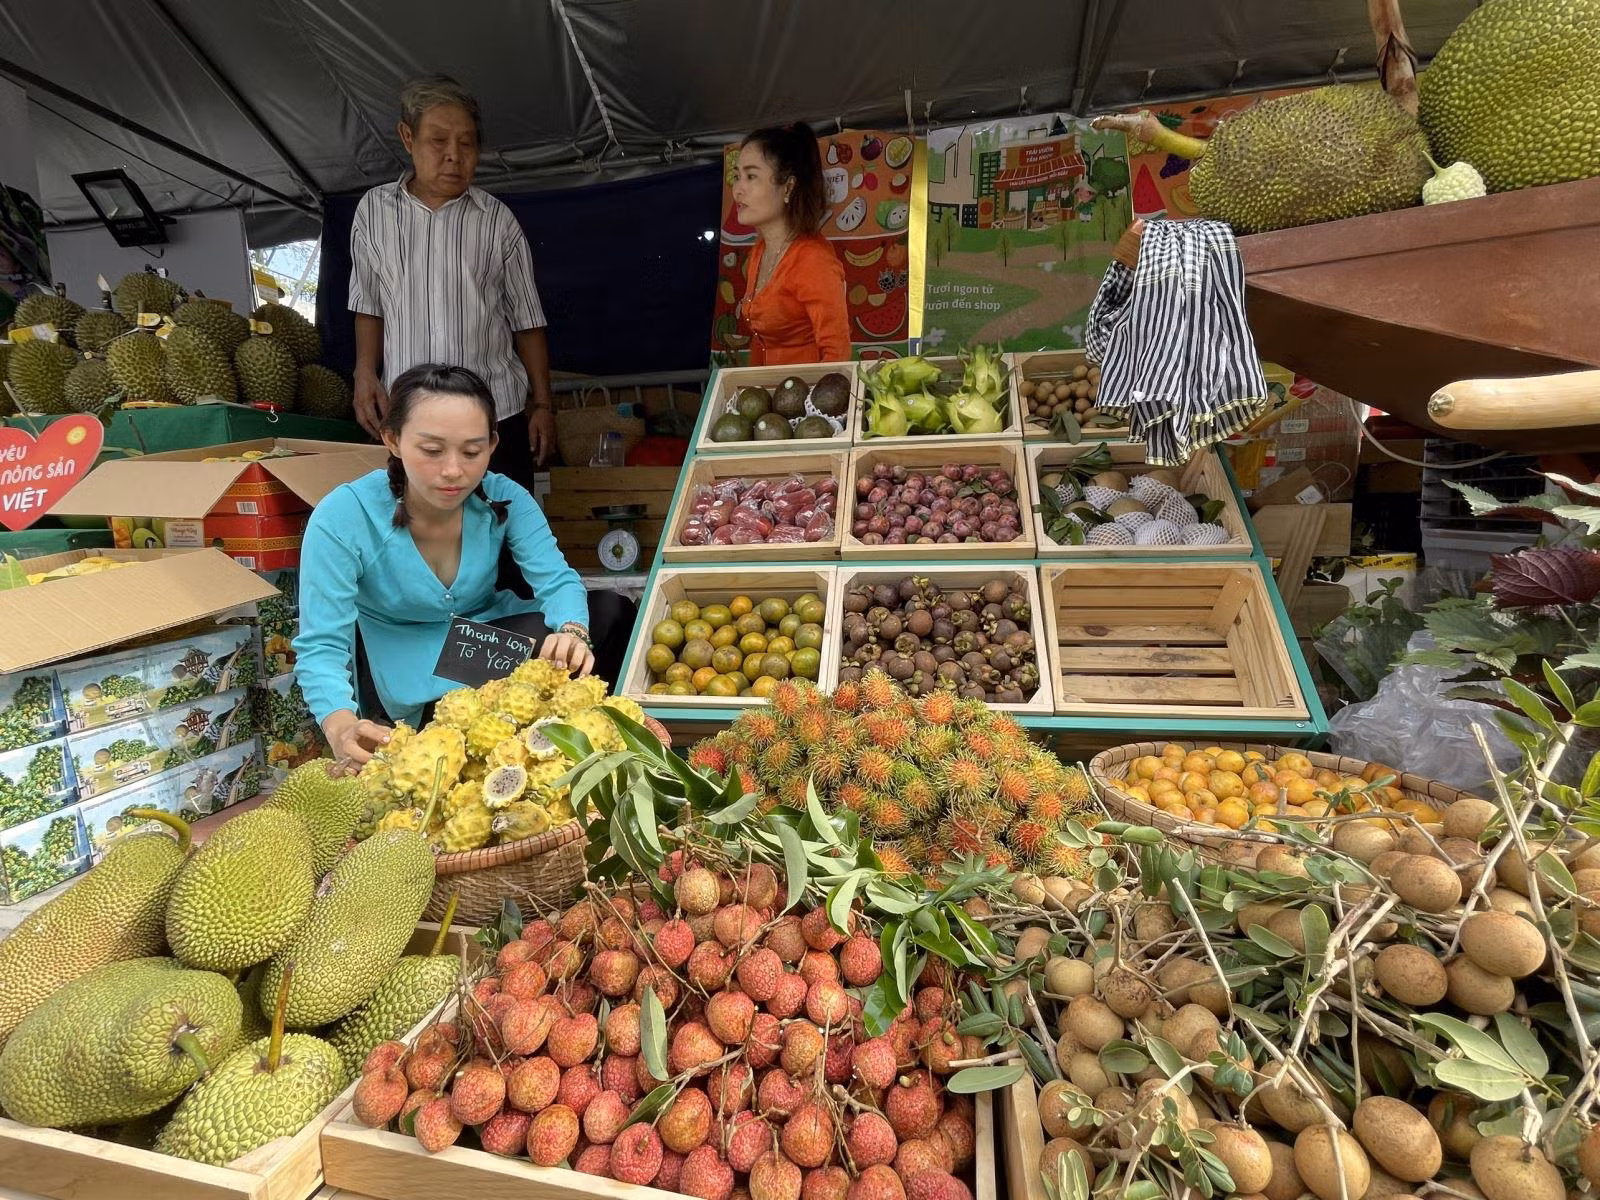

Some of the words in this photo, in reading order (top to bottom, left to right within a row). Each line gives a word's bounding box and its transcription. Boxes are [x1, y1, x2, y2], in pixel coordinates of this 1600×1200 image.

[953, 285, 979, 295] ngon
[974, 300, 1001, 313] shop
[3, 486, 48, 513] VIỆT
[454, 624, 500, 644] Thanh
